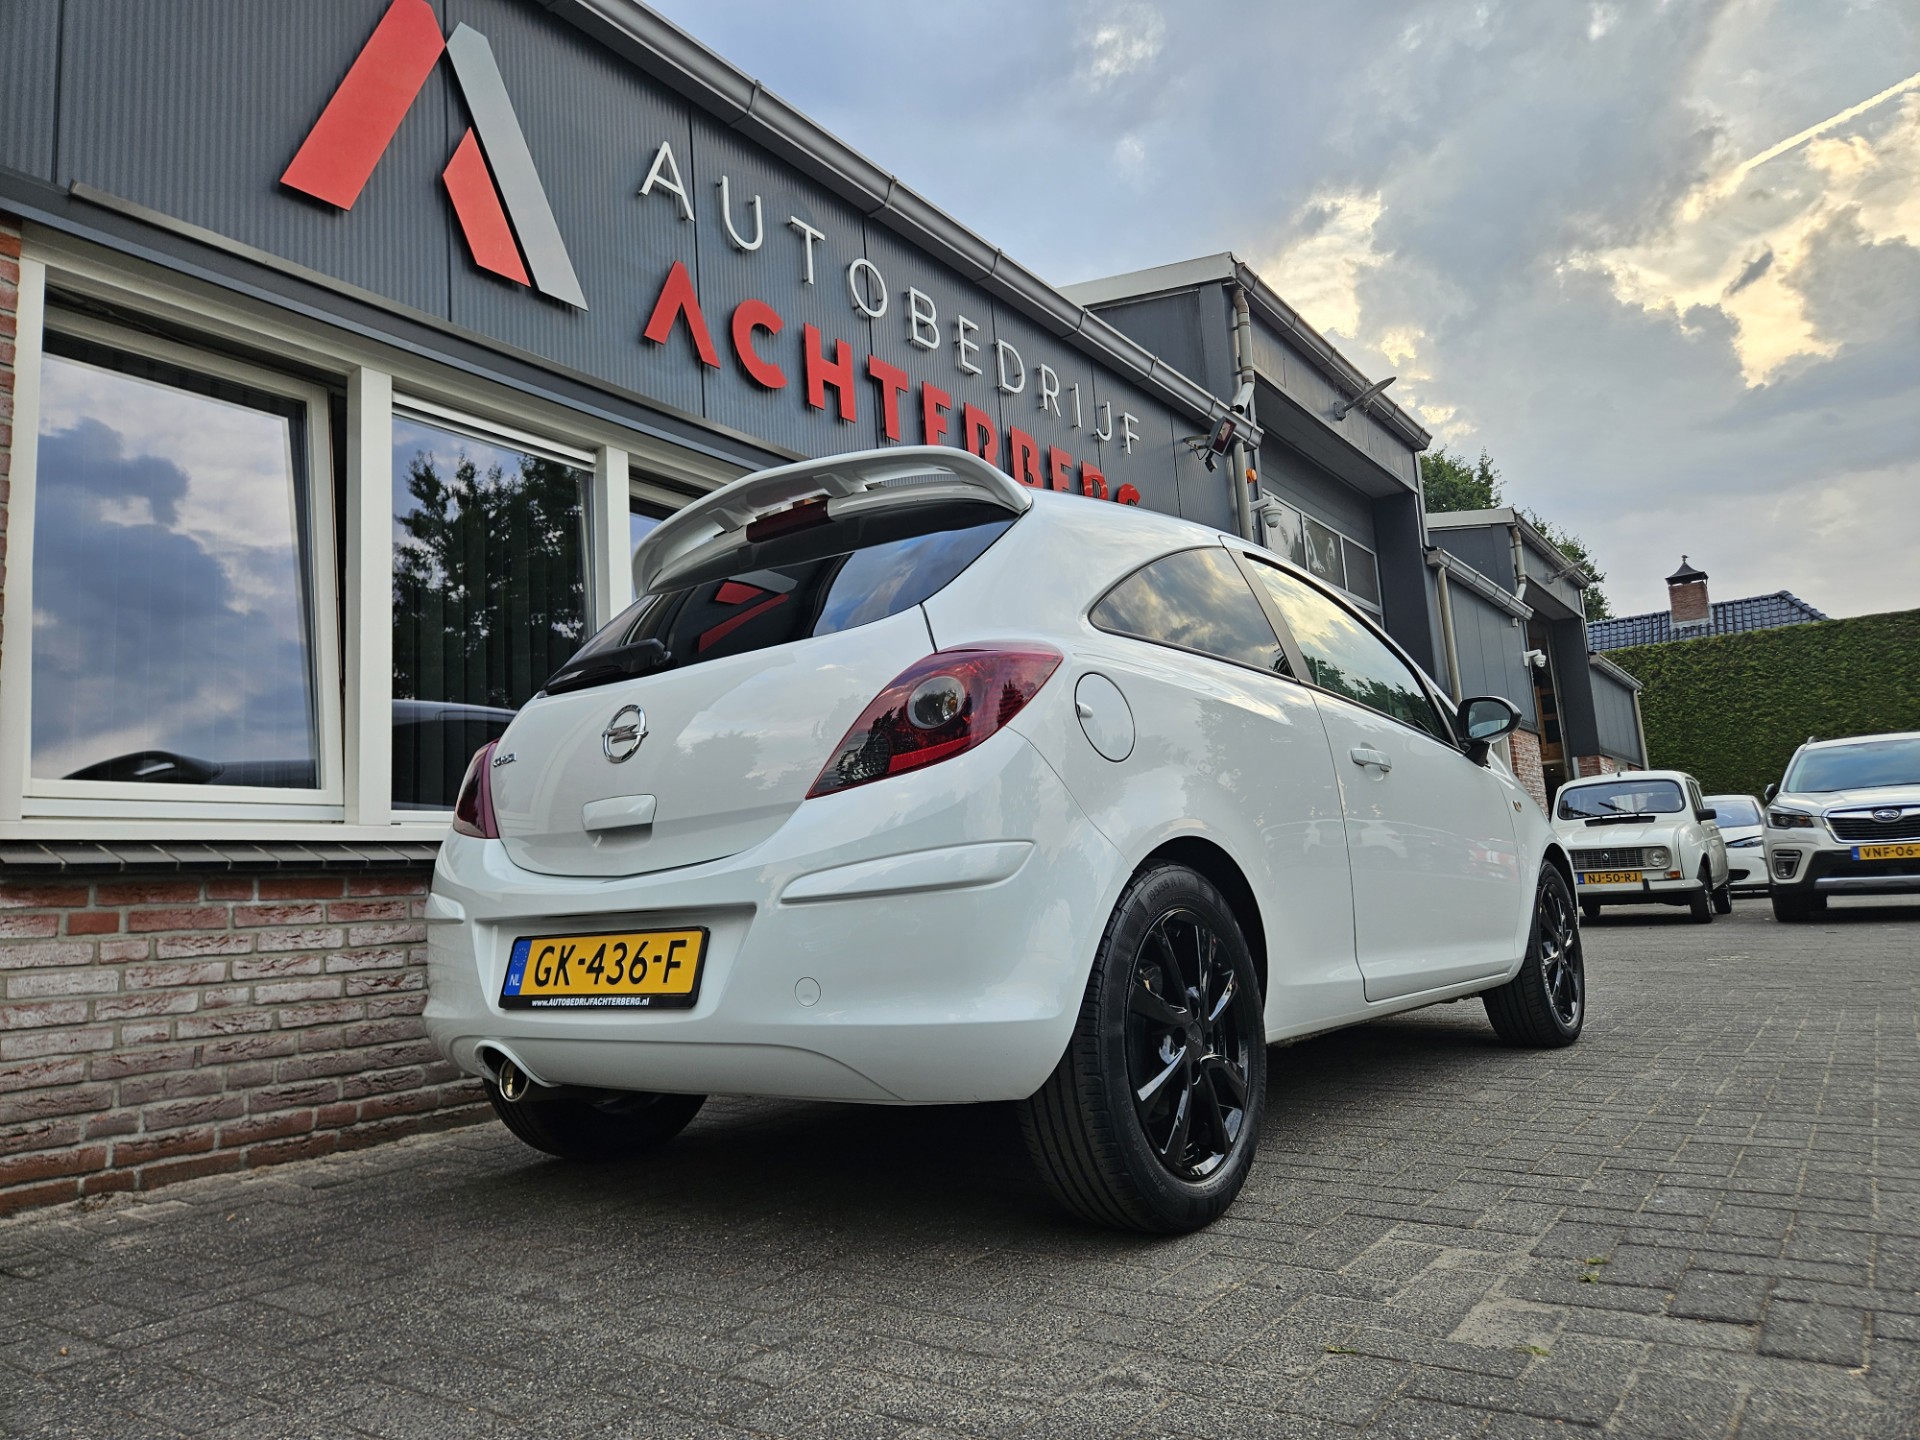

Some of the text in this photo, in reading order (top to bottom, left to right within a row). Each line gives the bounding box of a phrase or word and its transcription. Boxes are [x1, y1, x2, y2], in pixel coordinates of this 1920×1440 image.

[639, 141, 1140, 455] AUTOBEDRIJF
[1588, 873, 1638, 884] NJ-50-RJ
[534, 939, 687, 987] GK-436-F
[509, 974, 521, 986] NL
[531, 997, 650, 1007] www.AUTOBEDRIJFACHTERBERG.nl
